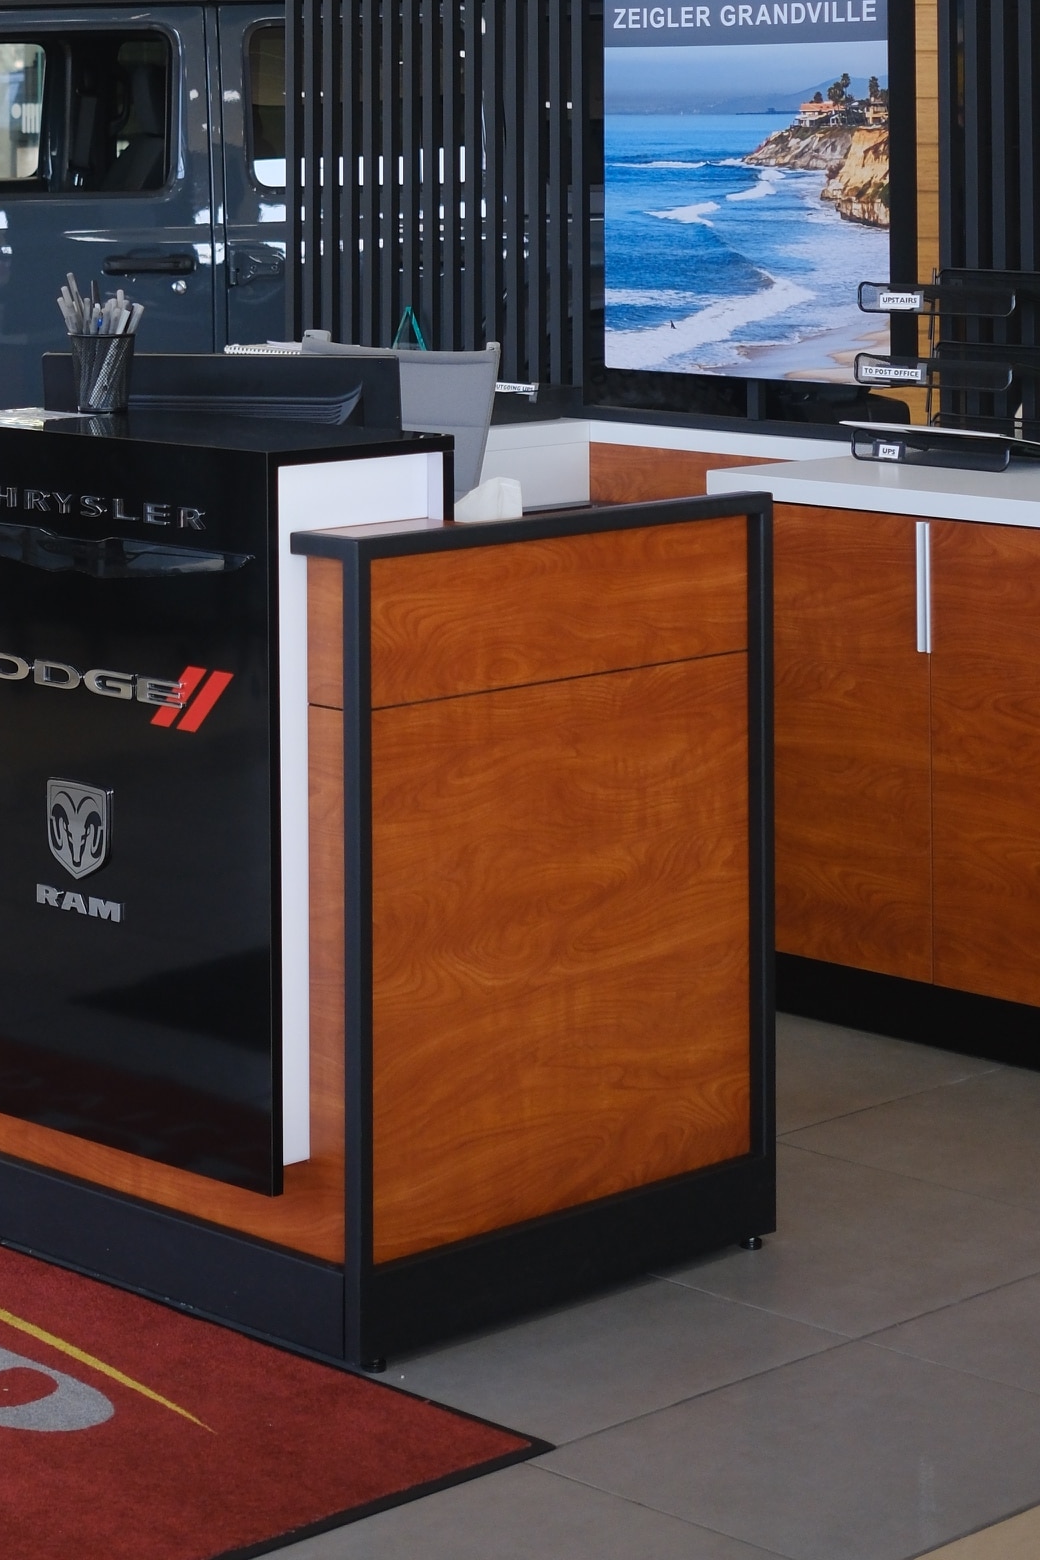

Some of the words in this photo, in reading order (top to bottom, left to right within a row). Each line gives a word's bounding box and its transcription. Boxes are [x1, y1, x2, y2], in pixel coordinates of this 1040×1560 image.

[613, 5, 711, 29] ZEIGLER
[719, 0, 877, 27] GRANDVILLE
[882, 296, 918, 305] UPSTAIRS
[864, 367, 874, 375] TO
[874, 368, 892, 376] POST
[893, 369, 920, 378] OFFICE
[495, 384, 521, 392] UTGOING
[881, 446, 896, 456] UPS
[36, 883, 125, 924] RAM
